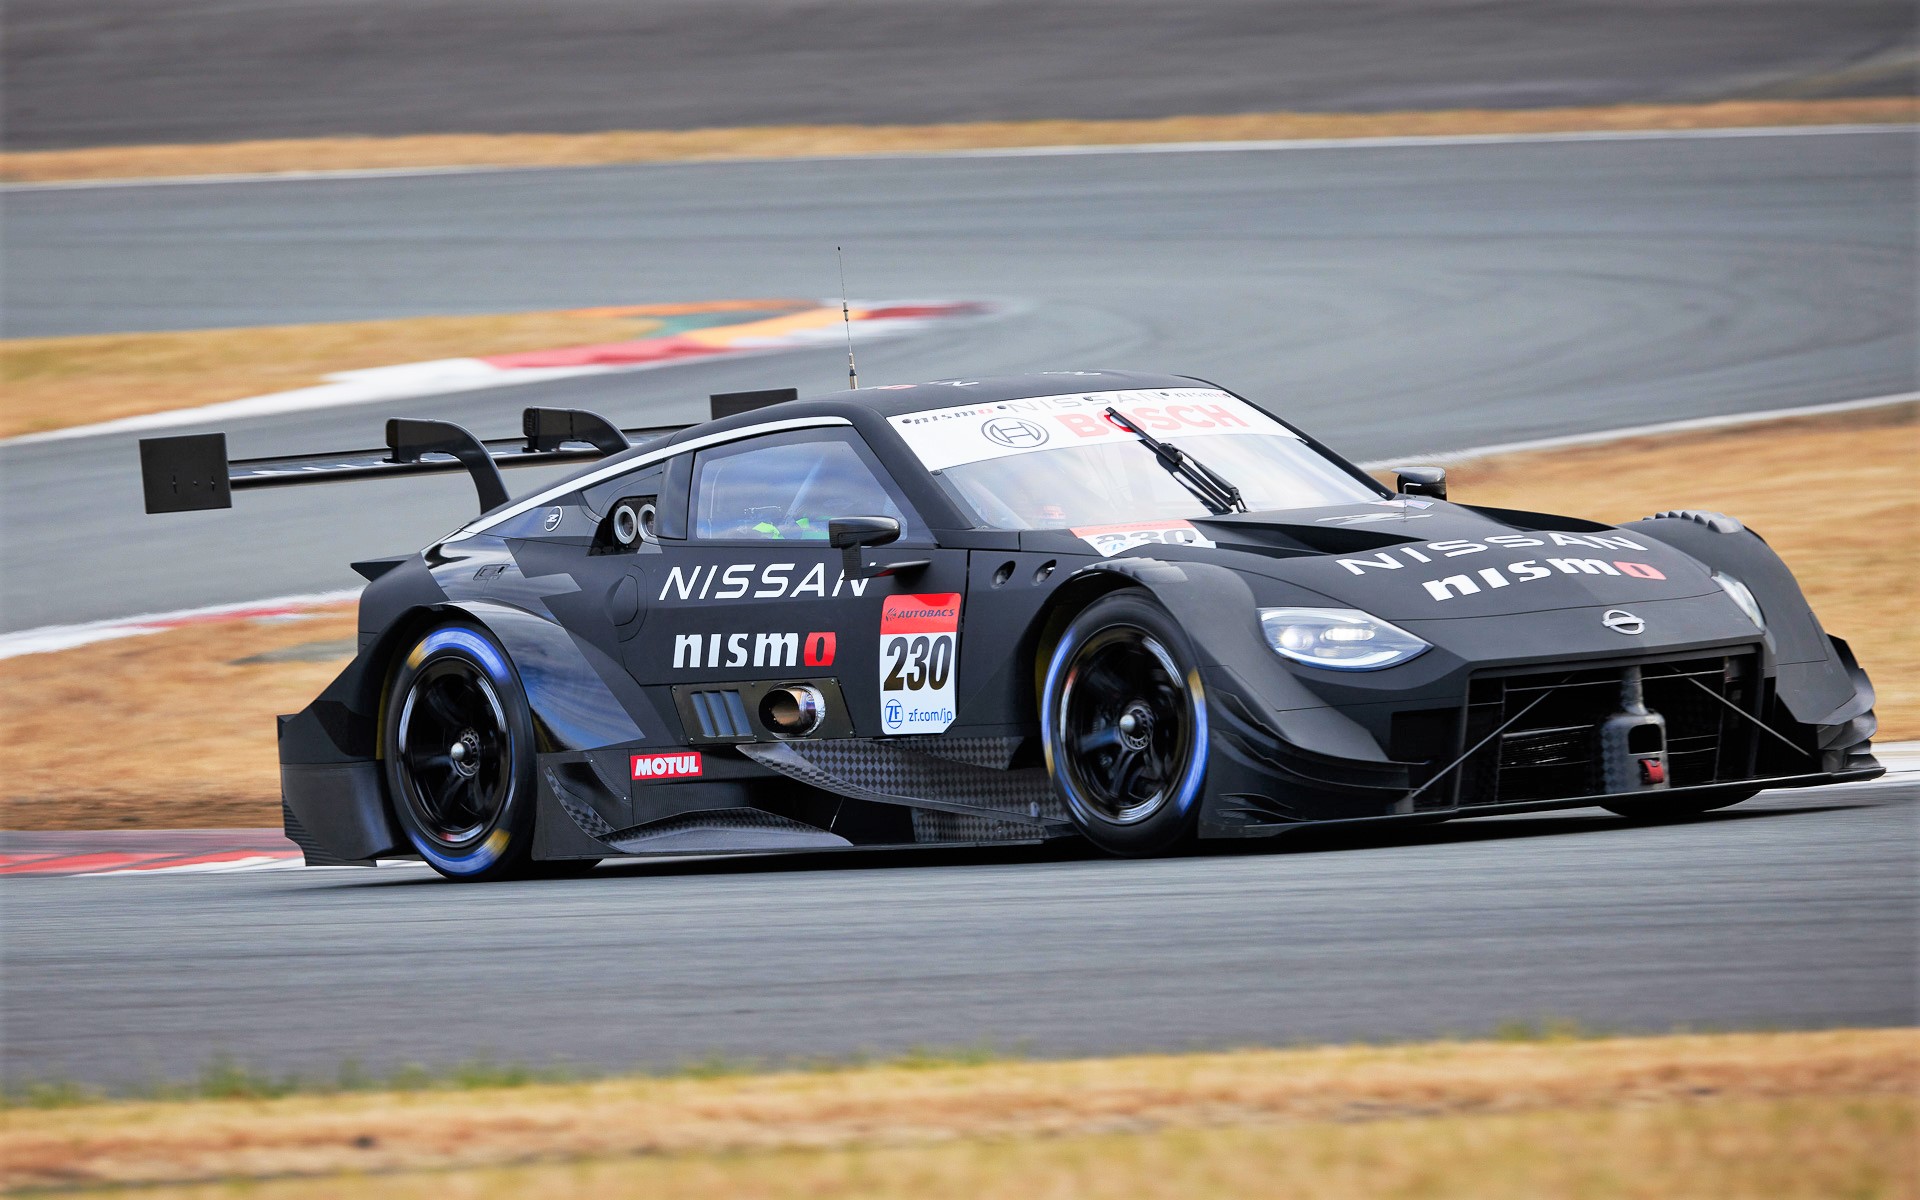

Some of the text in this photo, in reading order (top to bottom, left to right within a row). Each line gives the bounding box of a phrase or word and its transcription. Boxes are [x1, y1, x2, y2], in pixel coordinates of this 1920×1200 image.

[914, 408, 993, 424] nismo
[1008, 391, 1161, 413] NISSAN
[1054, 404, 1250, 438] BOSCH
[1335, 532, 1649, 576] NISSAN
[1421, 557, 1667, 601] nismo
[897, 608, 955, 619] AUTOBACS
[673, 632, 837, 668] nismo
[883, 635, 953, 691] 230
[885, 704, 953, 723] ZF zf.com/jp
[634, 755, 699, 777] MOTUL
